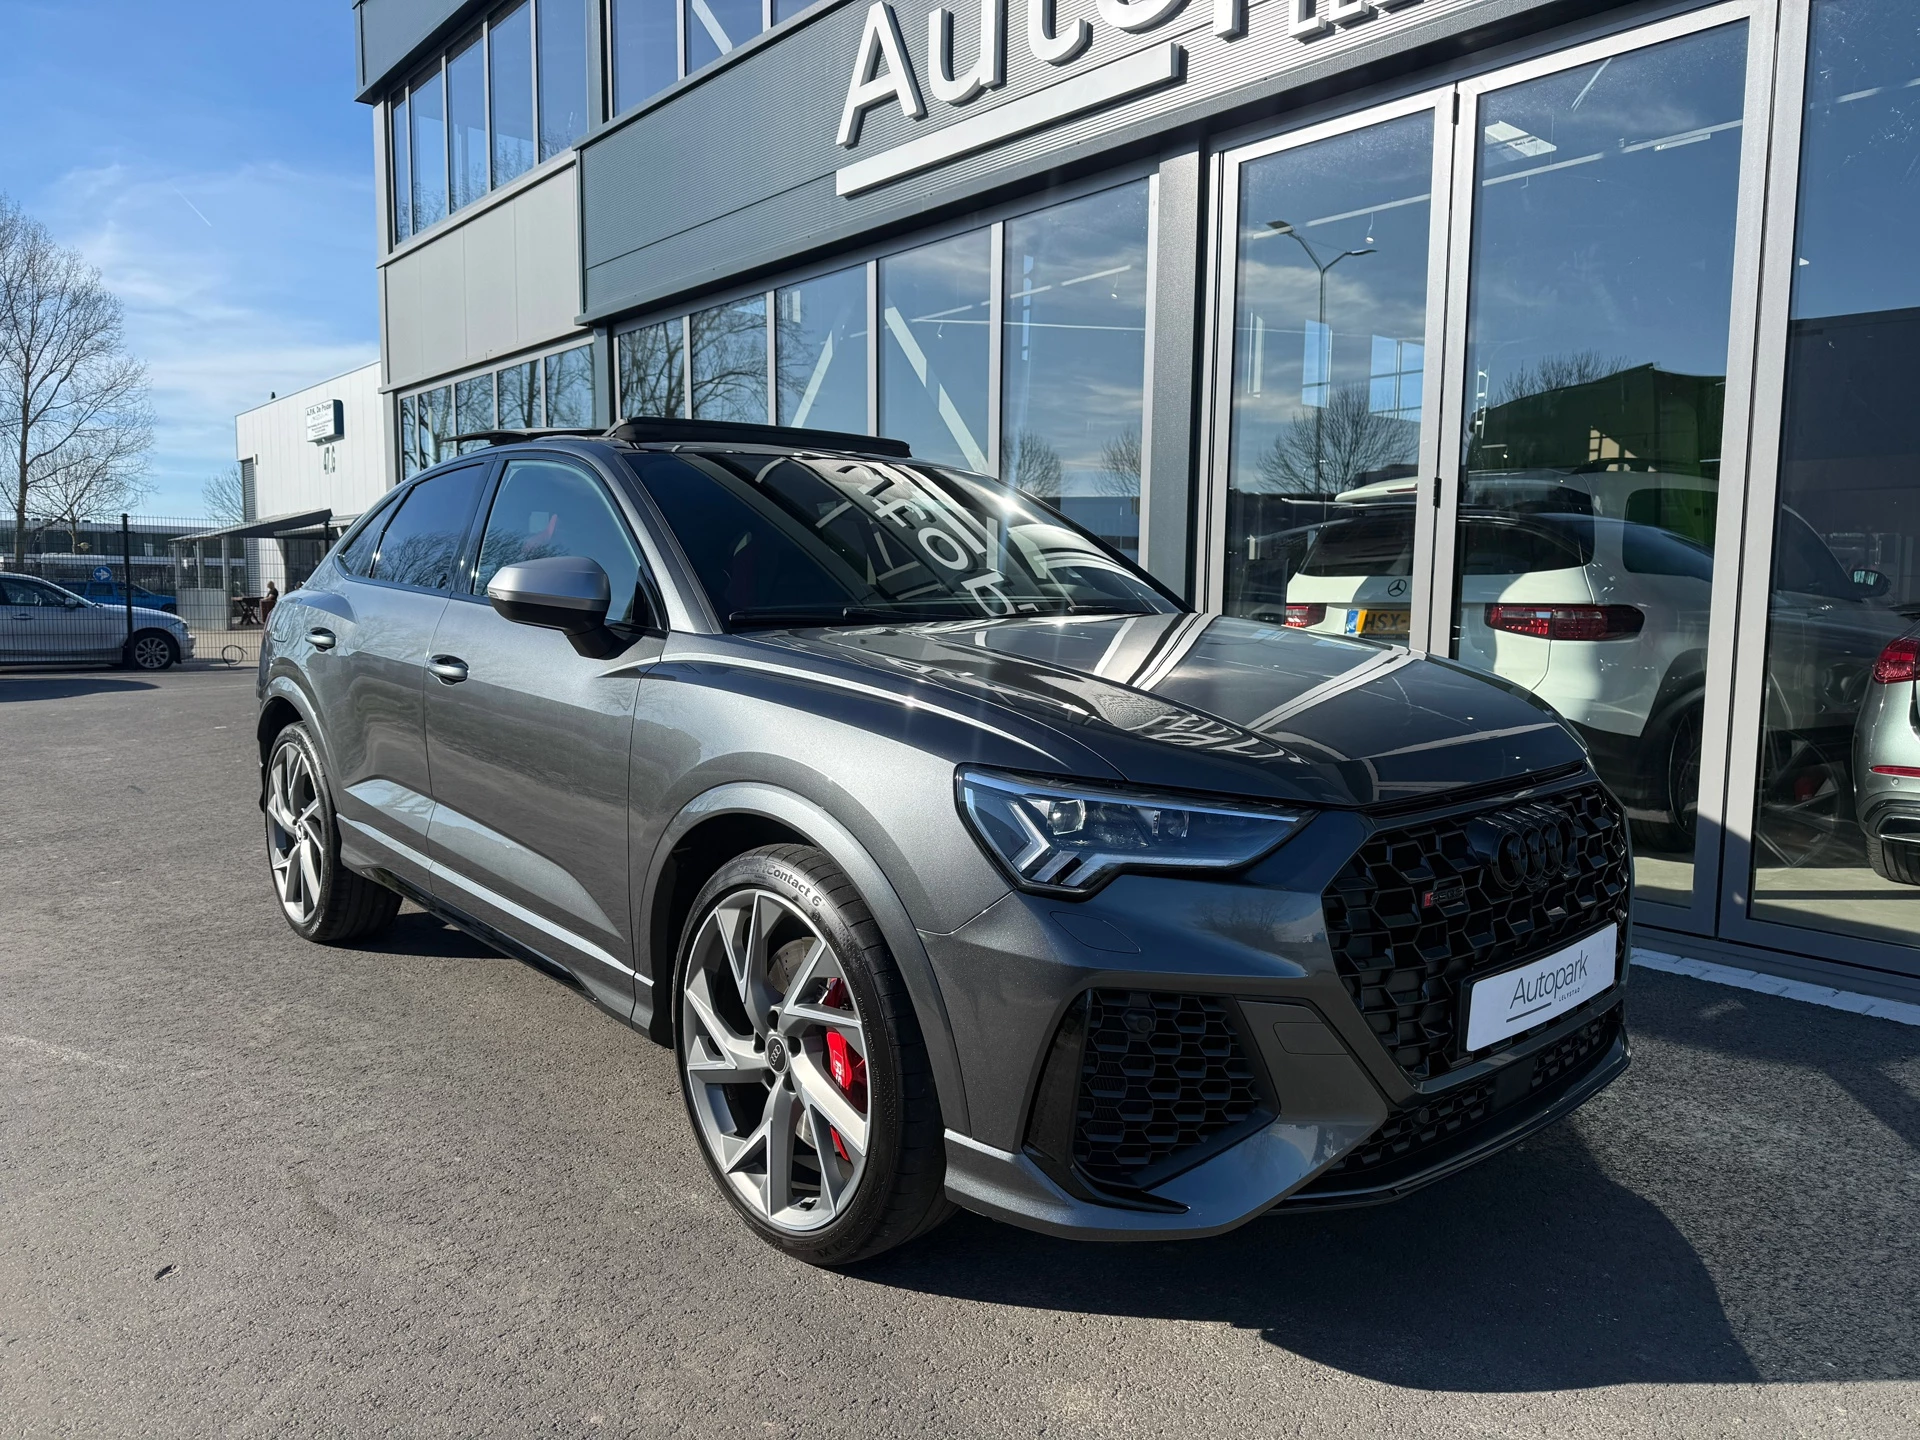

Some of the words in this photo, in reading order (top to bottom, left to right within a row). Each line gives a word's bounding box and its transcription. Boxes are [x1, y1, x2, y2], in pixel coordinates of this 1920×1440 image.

[811, 895, 823, 908] 6
[1509, 950, 1589, 1010] Autopark
[1558, 987, 1581, 1002] LELYSTAD
